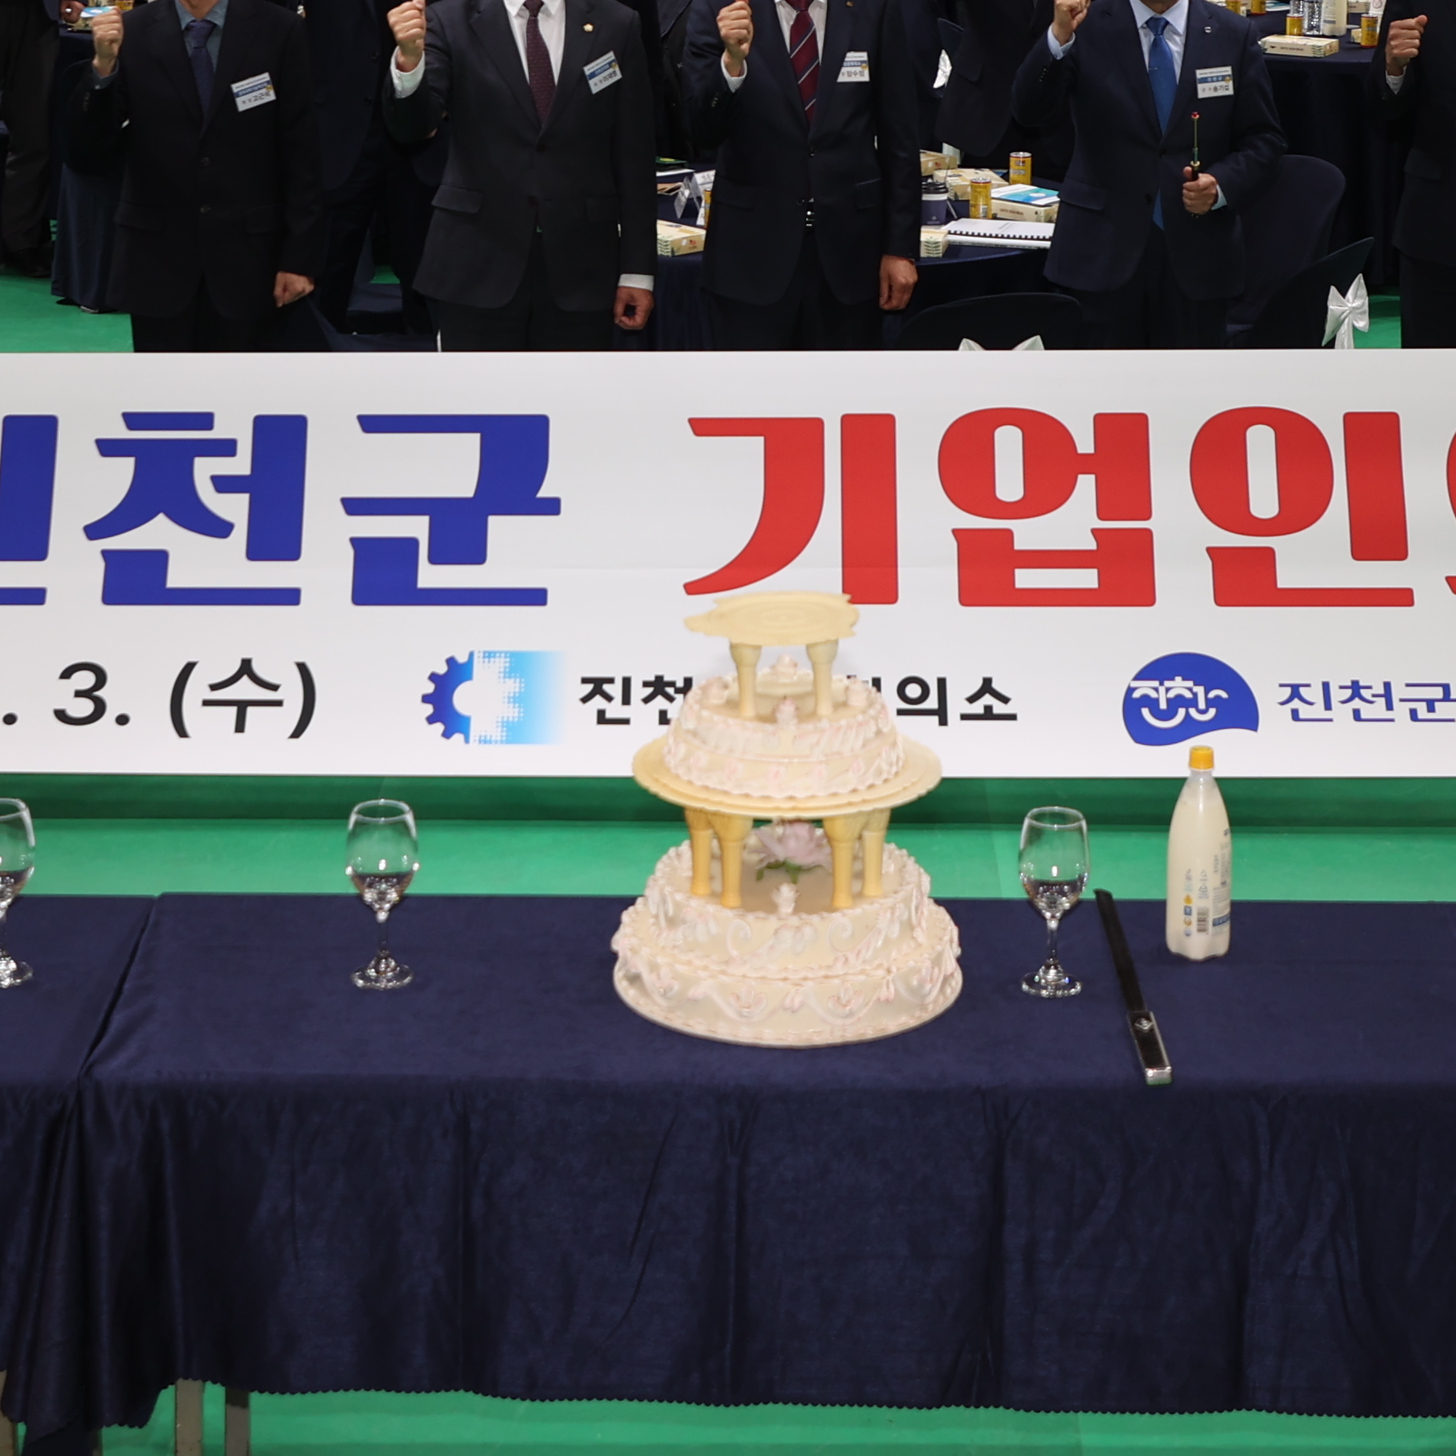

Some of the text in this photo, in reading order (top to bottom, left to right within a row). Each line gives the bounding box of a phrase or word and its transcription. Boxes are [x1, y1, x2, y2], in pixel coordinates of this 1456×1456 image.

[53, 661, 130, 726] 3.
[169, 659, 316, 739] (수)
[579, 675, 1018, 726] 진천의소
